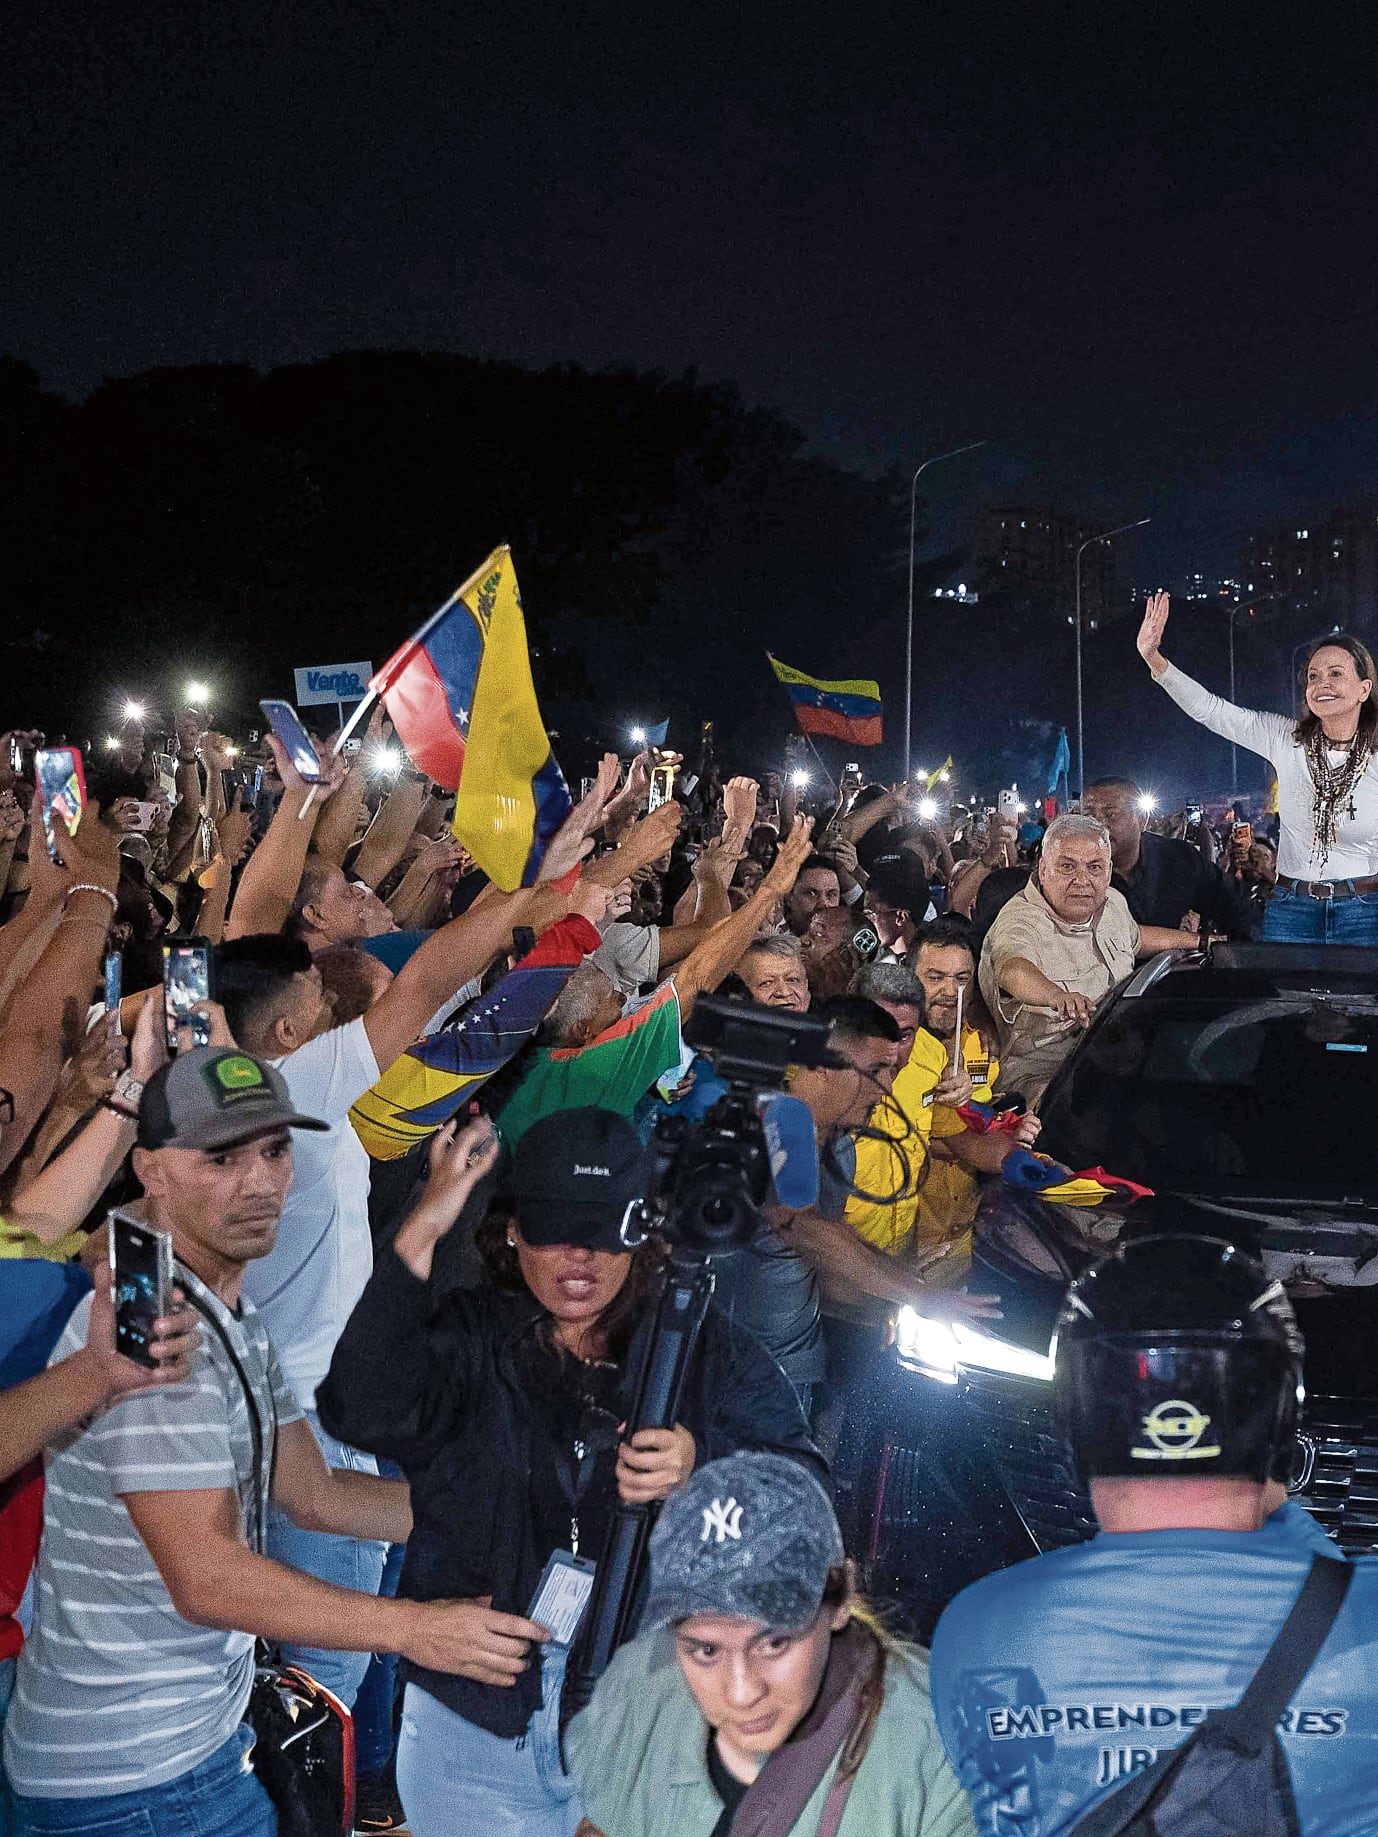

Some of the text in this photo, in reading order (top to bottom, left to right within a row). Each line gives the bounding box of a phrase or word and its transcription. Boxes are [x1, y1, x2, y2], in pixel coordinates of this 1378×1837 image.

[307, 670, 360, 692] Vente
[700, 1496, 744, 1542] NY
[987, 1704, 1348, 1740] EMPRENDERES
[1097, 1746, 1157, 1786] JIR
